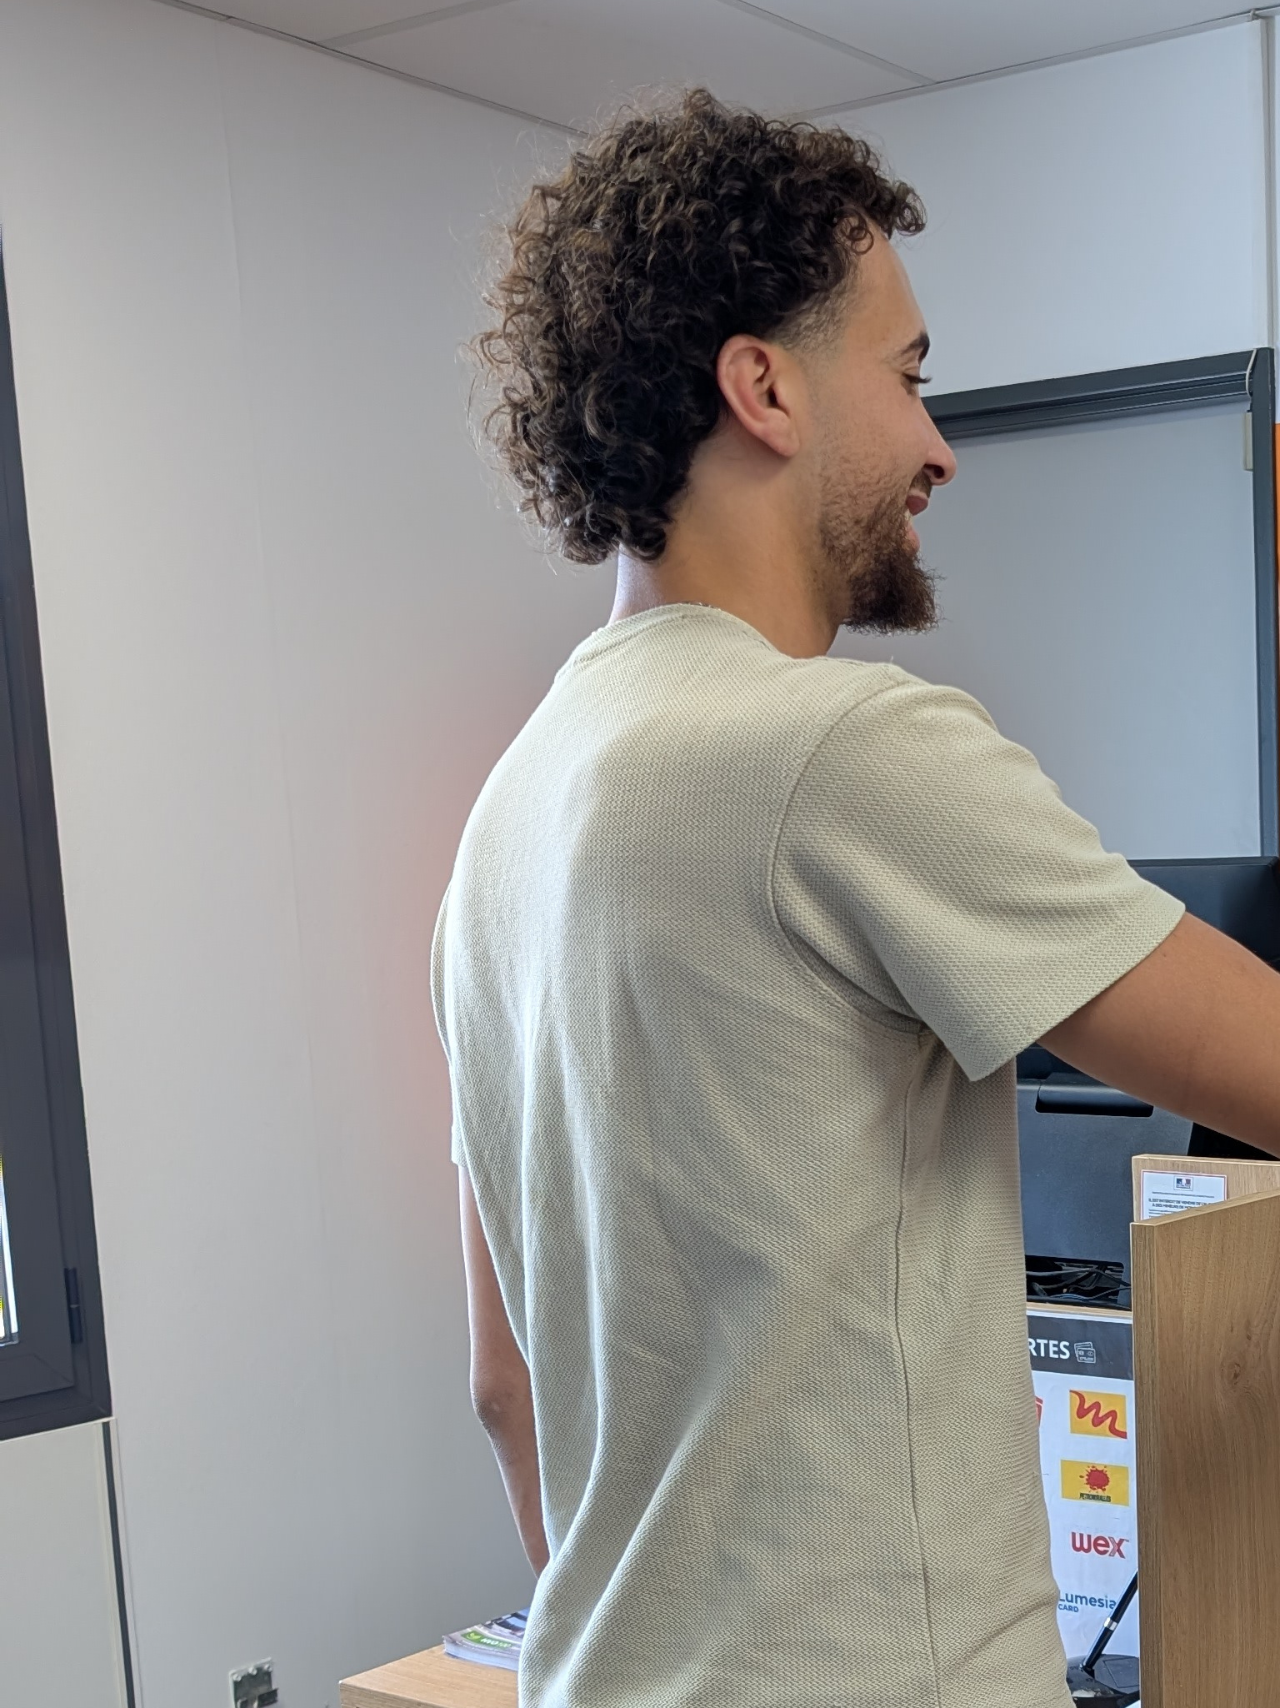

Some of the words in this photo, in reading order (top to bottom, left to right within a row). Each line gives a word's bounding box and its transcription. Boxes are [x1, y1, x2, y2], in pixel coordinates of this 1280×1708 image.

[1027, 1337, 1071, 1360] RTES
[1071, 1531, 1130, 1559] wex
[1058, 1603, 1079, 1613] CARD
